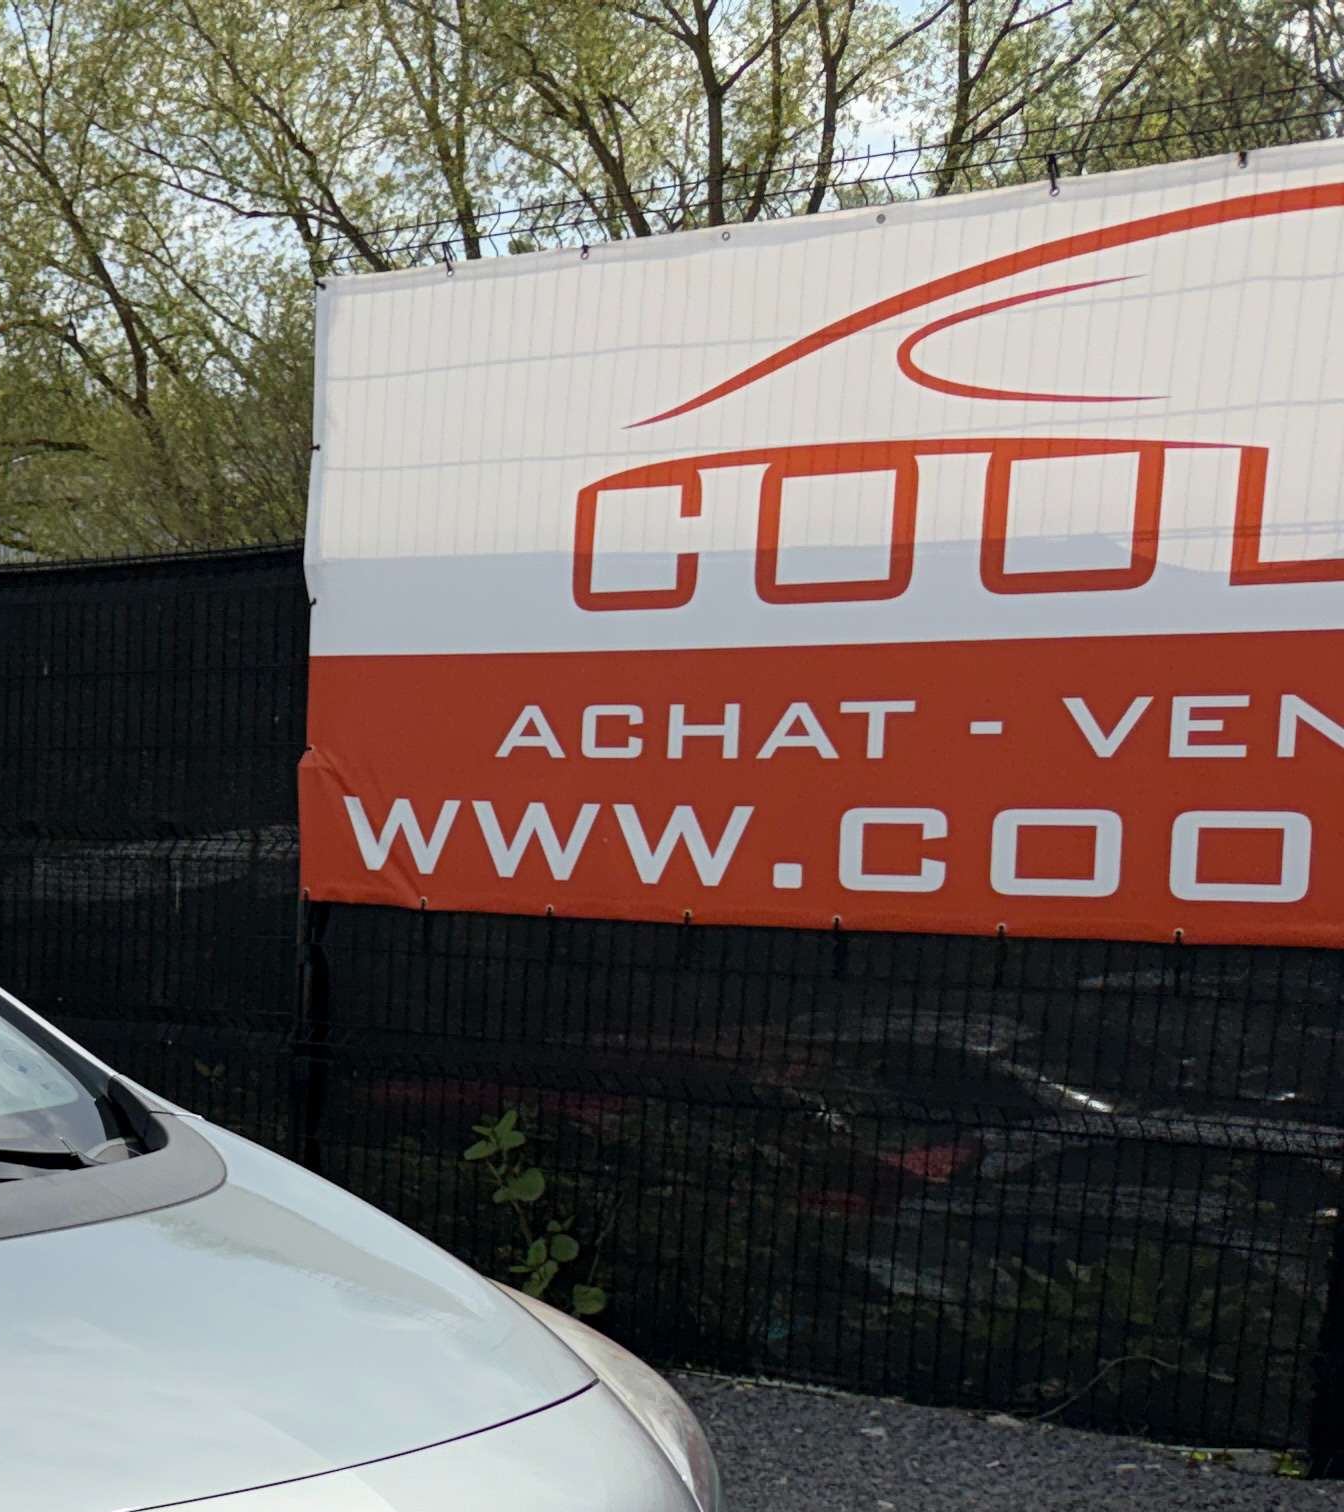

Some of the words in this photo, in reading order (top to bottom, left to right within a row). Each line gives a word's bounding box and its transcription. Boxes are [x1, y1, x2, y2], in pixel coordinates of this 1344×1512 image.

[495, 699, 917, 760] ACHAT
[1062, 694, 1344, 758] VEN
[344, 796, 1312, 903] WWW.COO
